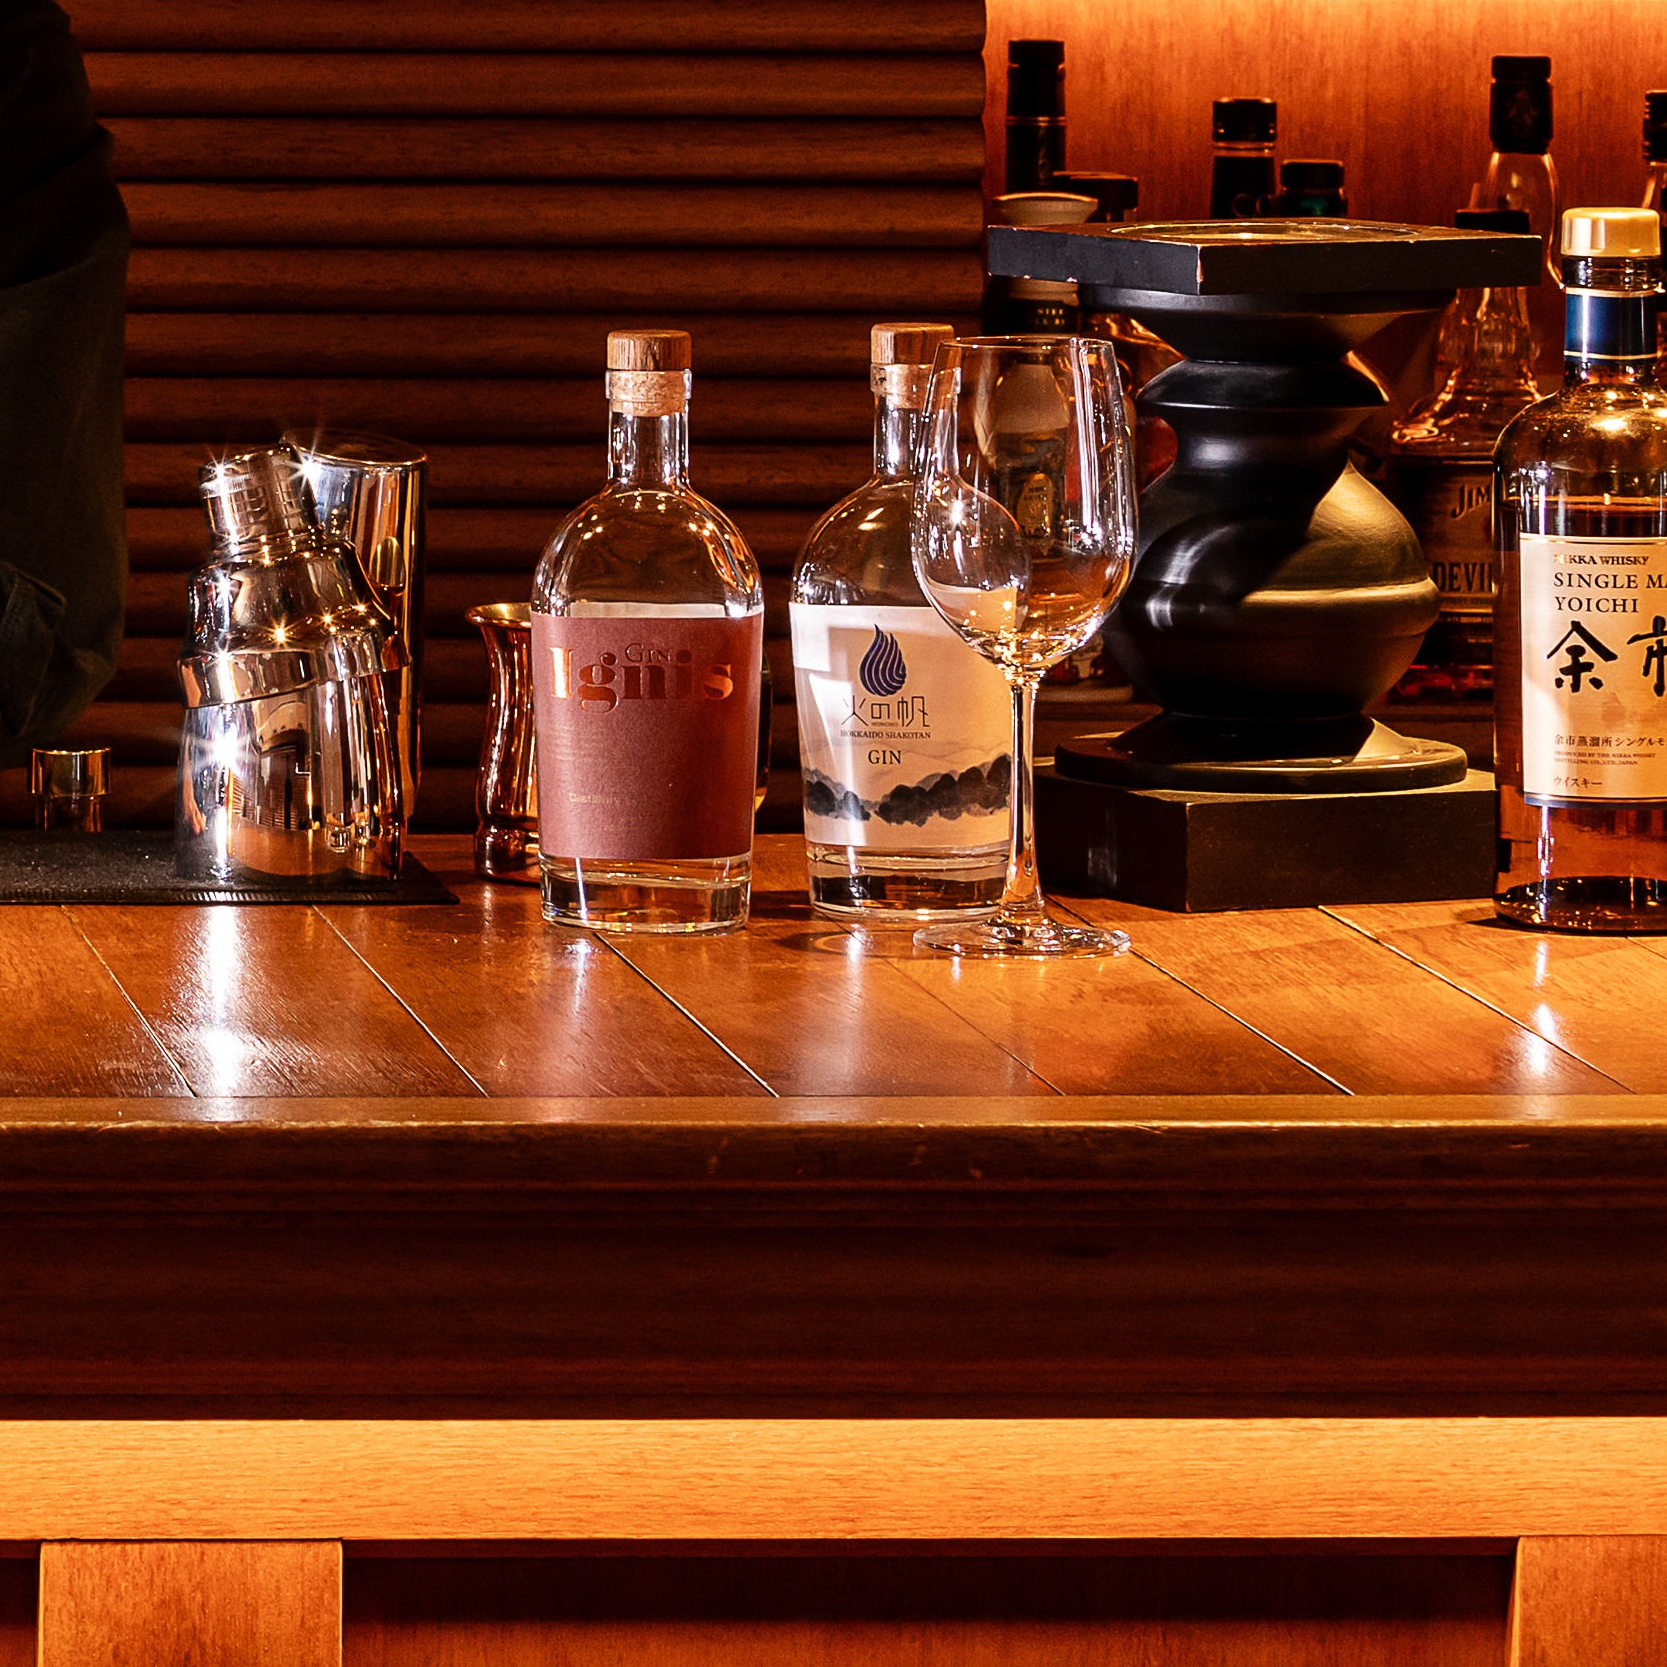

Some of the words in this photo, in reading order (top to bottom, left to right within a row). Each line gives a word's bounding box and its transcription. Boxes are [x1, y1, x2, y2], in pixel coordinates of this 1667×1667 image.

[1450, 484, 1491, 520] JIM
[1553, 554, 1598, 565] NIKKA
[1598, 555, 1650, 566] WHISKY
[1553, 571, 1639, 589] SINGLE
[1554, 595, 1639, 613] YOICHI
[1543, 614, 1667, 698] 余市
[548, 645, 735, 714] Ignis
[840, 694, 931, 728] 火の帆
[840, 729, 885, 739] HOKKAIDO
[885, 730, 931, 740] SHAKOTAN
[867, 749, 902, 765] GIN
[1553, 775, 1603, 789] ウイスキー
